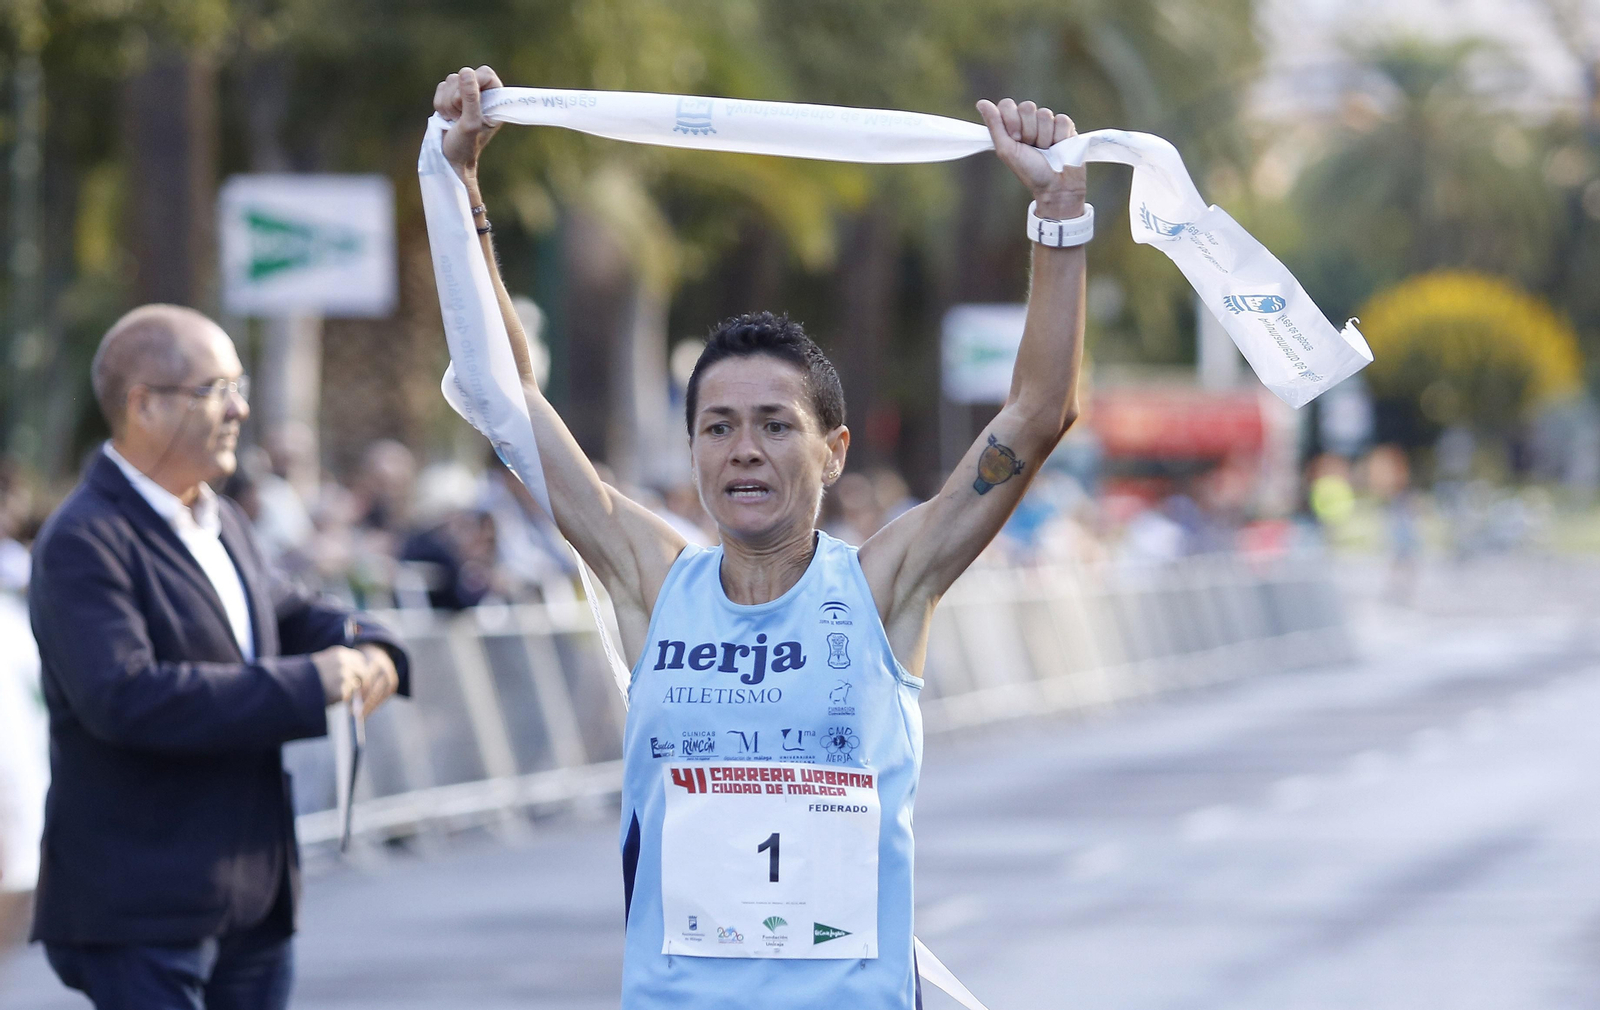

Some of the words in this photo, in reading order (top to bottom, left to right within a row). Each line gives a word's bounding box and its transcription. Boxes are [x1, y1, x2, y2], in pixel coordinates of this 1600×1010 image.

[653, 633, 807, 686] nerja
[662, 687, 783, 705] ATLETISMO
[828, 726, 853, 736] CMD
[826, 753, 853, 764] NERJA
[670, 767, 707, 794] 41
[709, 767, 796, 782] CARRERA
[801, 769, 874, 789] URBANA
[711, 783, 762, 794] CIUDAD
[765, 784, 783, 794] DE
[787, 782, 847, 796] MÁLAGA
[808, 804, 868, 814] FEDERADO
[757, 832, 780, 883] 1
